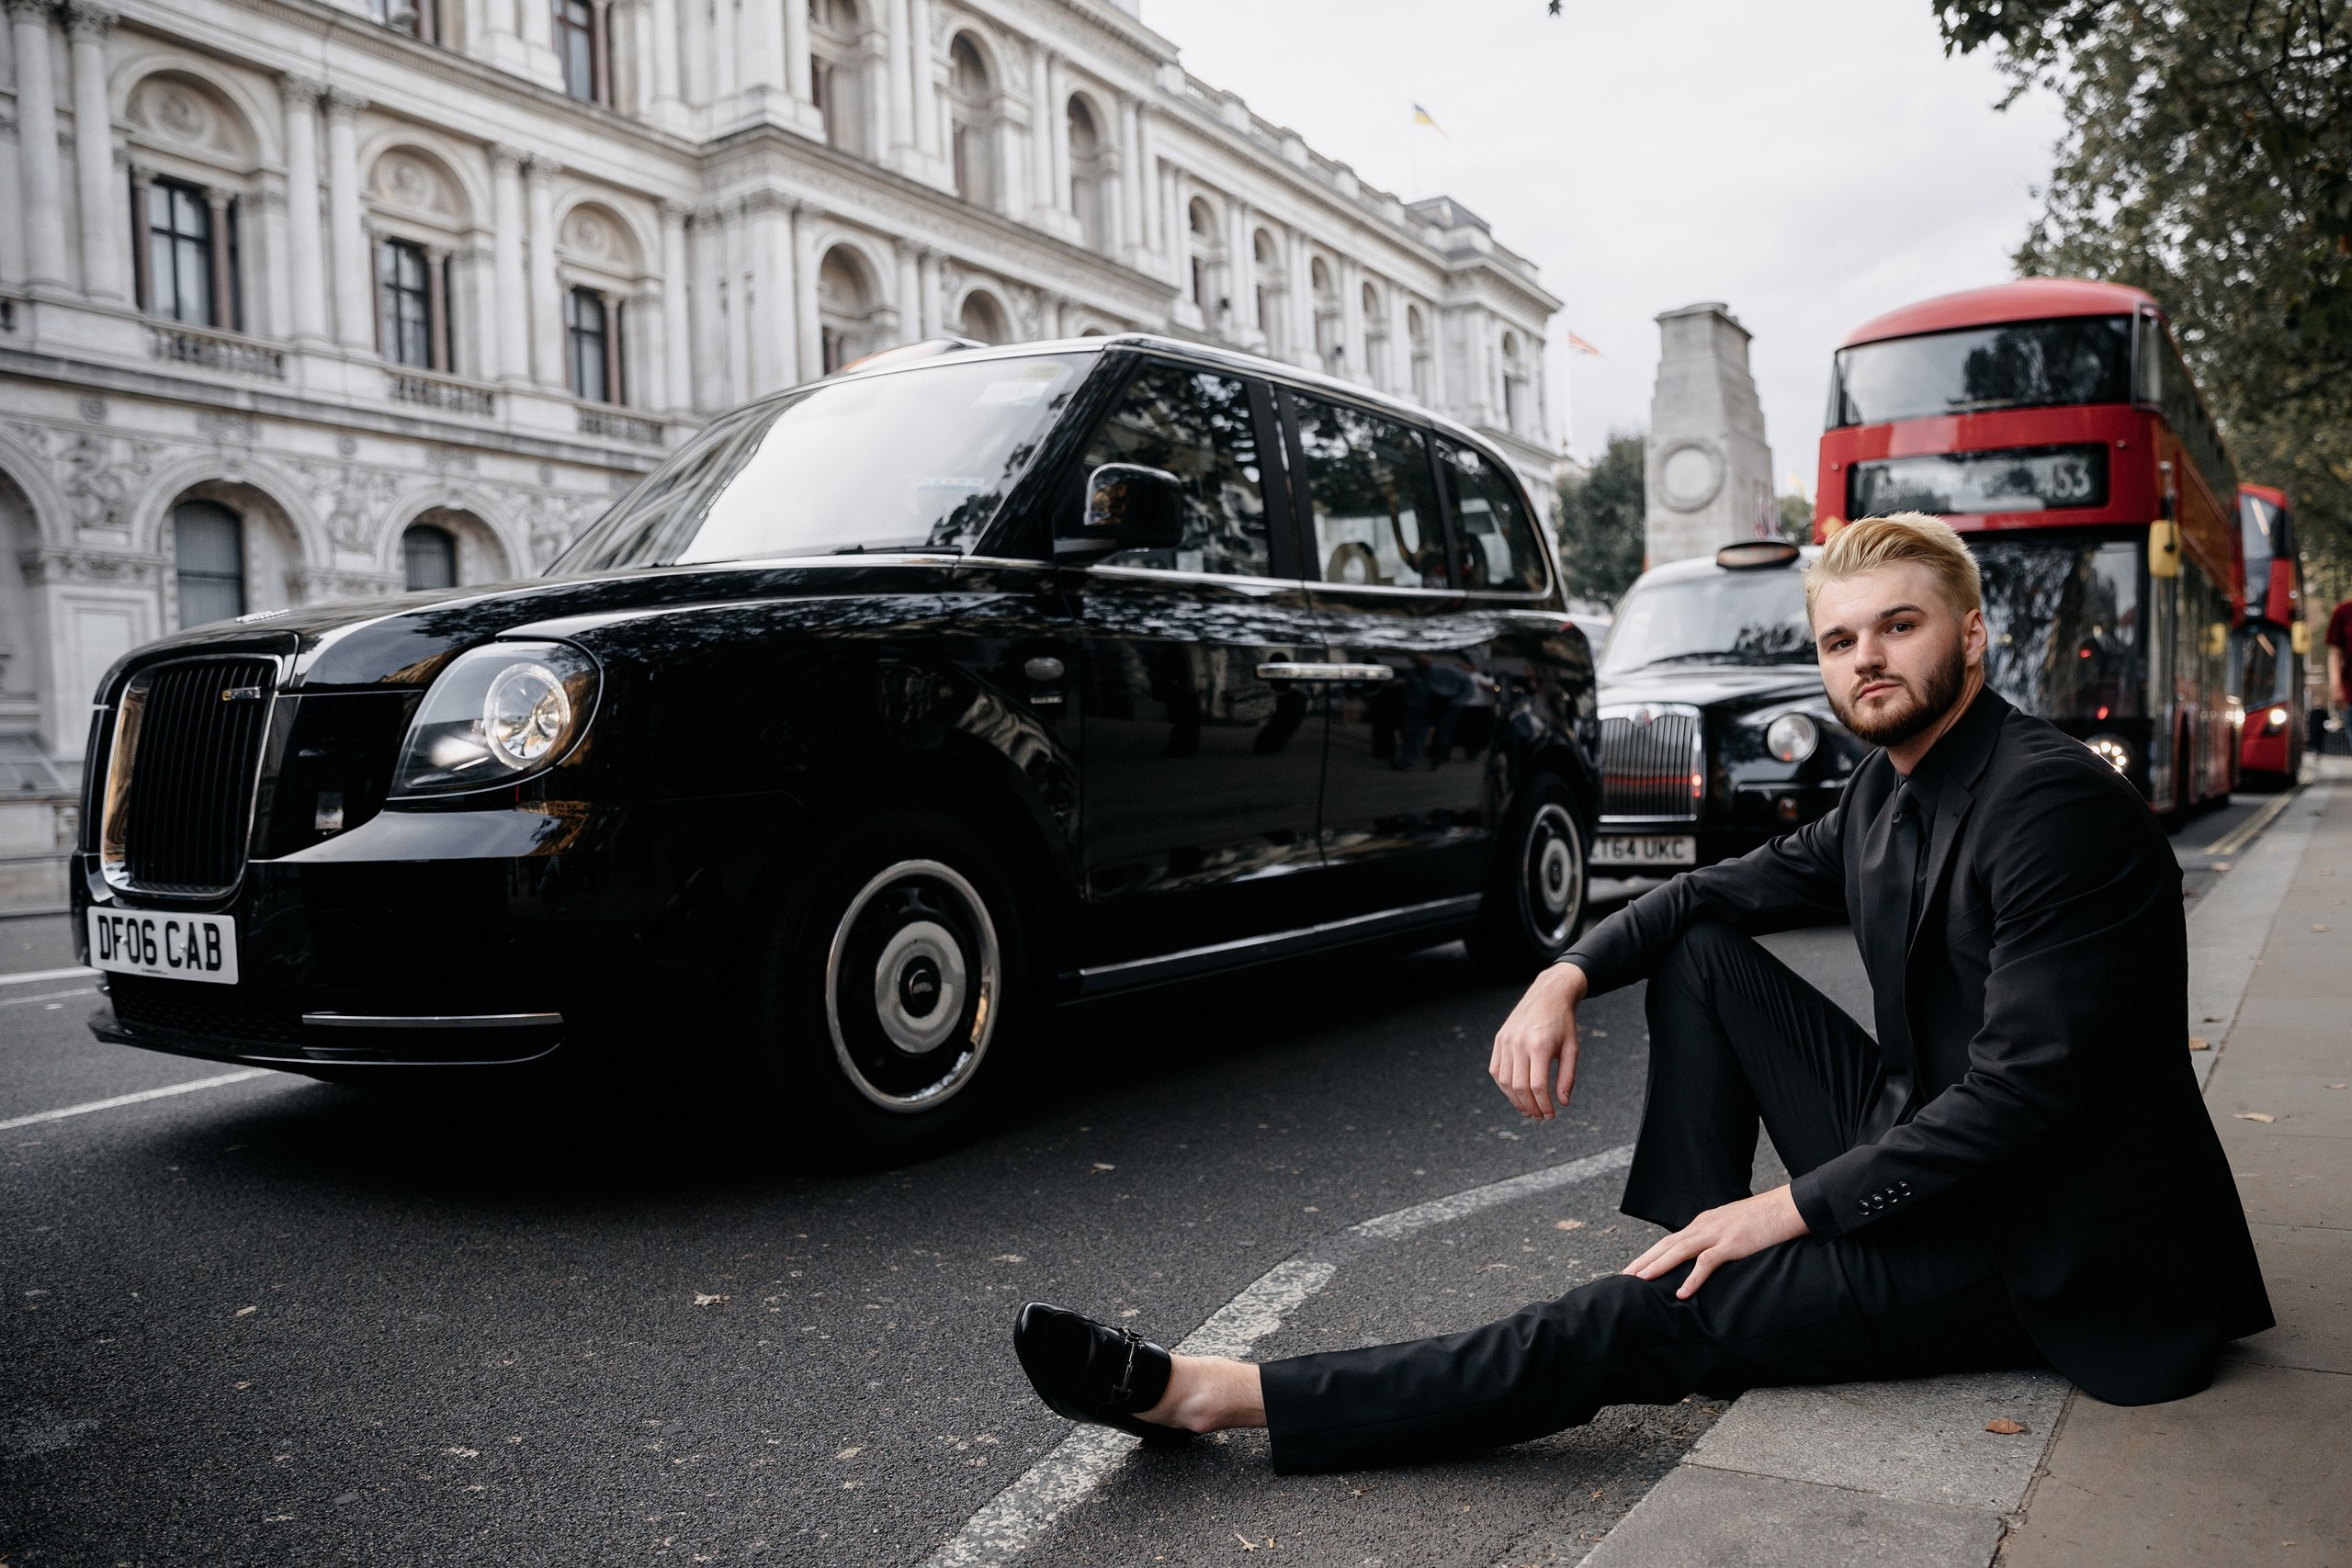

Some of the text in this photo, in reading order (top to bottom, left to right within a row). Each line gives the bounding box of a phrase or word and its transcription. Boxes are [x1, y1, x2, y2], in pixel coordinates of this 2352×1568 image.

[1591, 835, 1685, 859] T64 UKC
[97, 915, 222, 971] DF06 CAB
